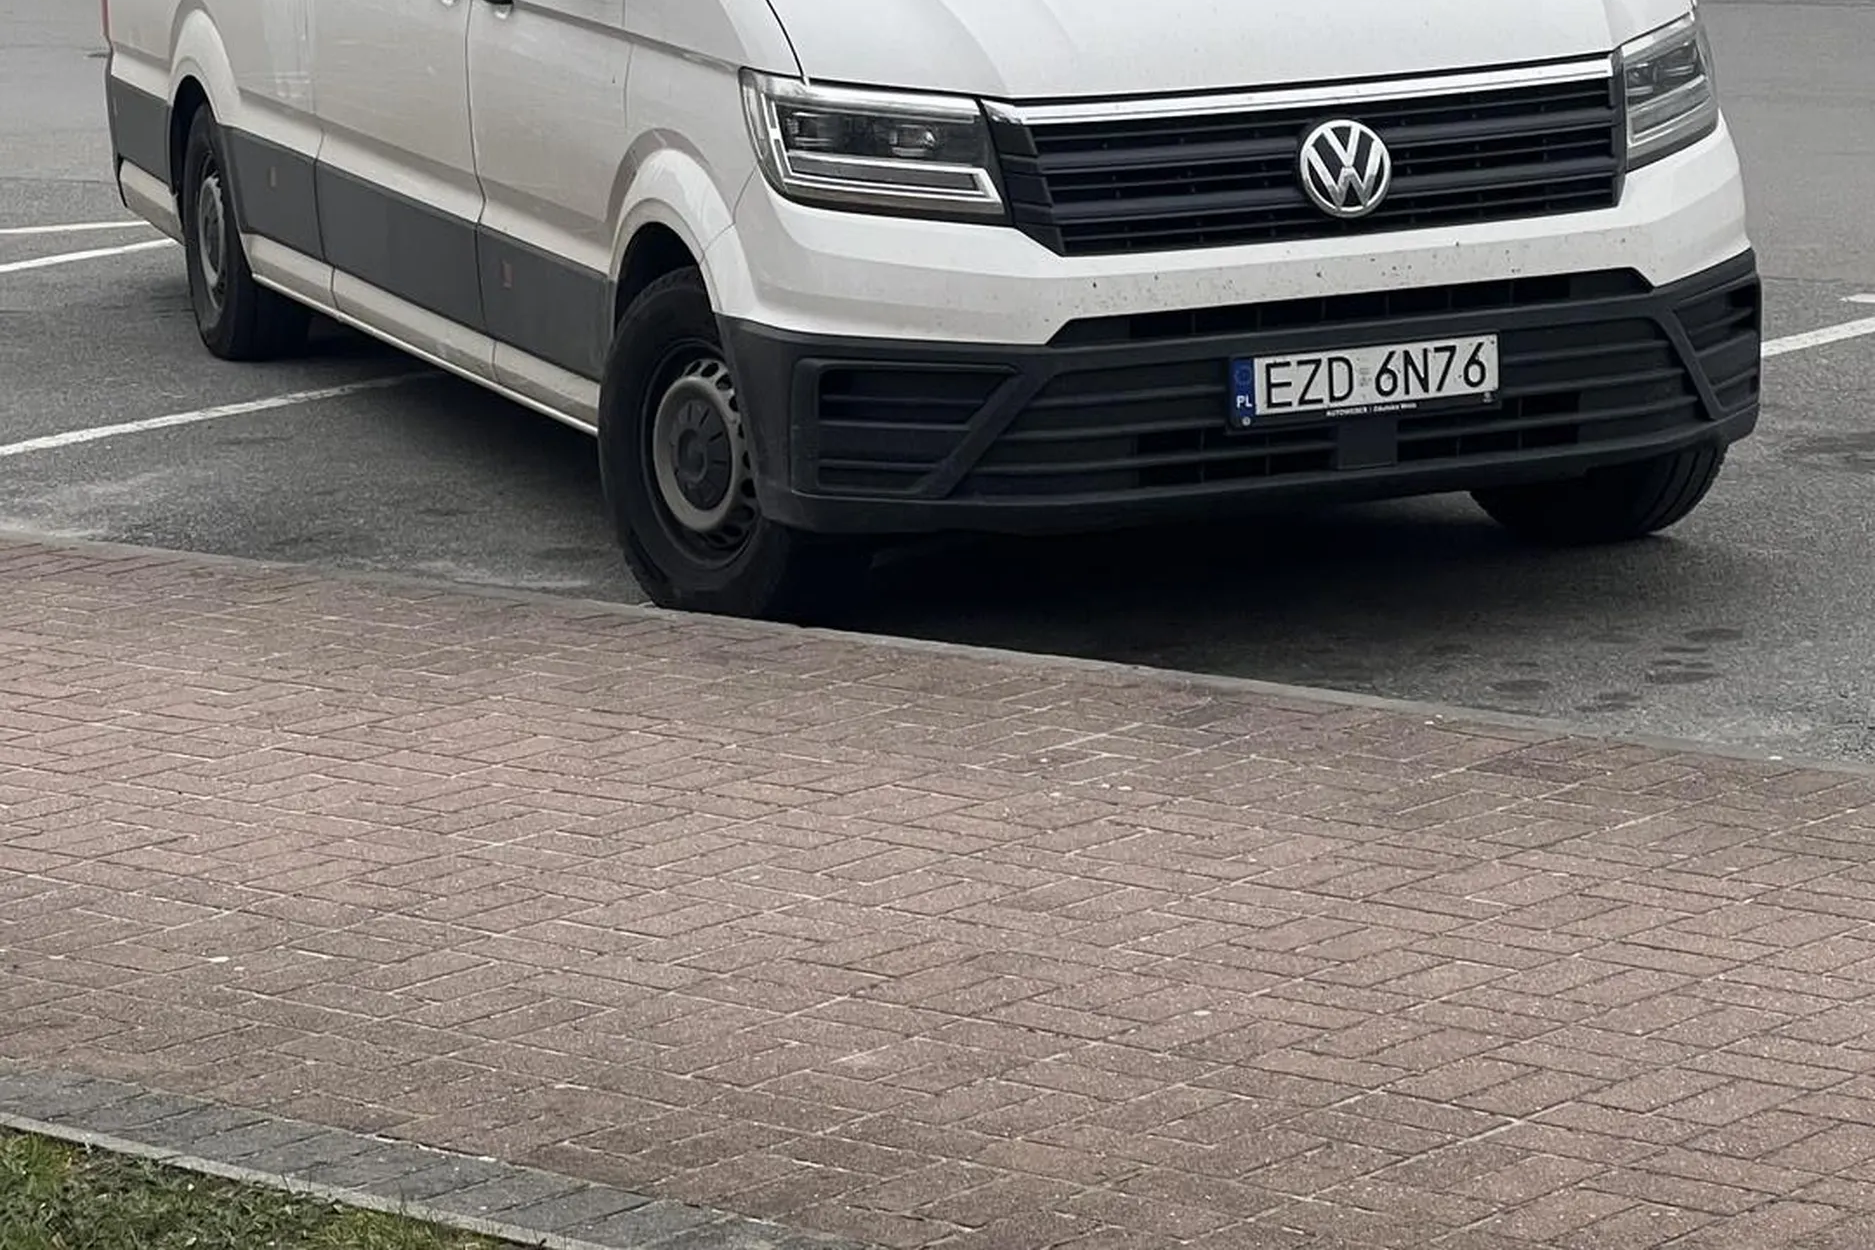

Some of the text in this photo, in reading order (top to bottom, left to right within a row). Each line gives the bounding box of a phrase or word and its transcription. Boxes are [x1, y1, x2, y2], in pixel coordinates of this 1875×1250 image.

[1304, 121, 1387, 211] VW
[1236, 395, 1253, 408] PL
[1265, 342, 1487, 409] EZD 6N76
